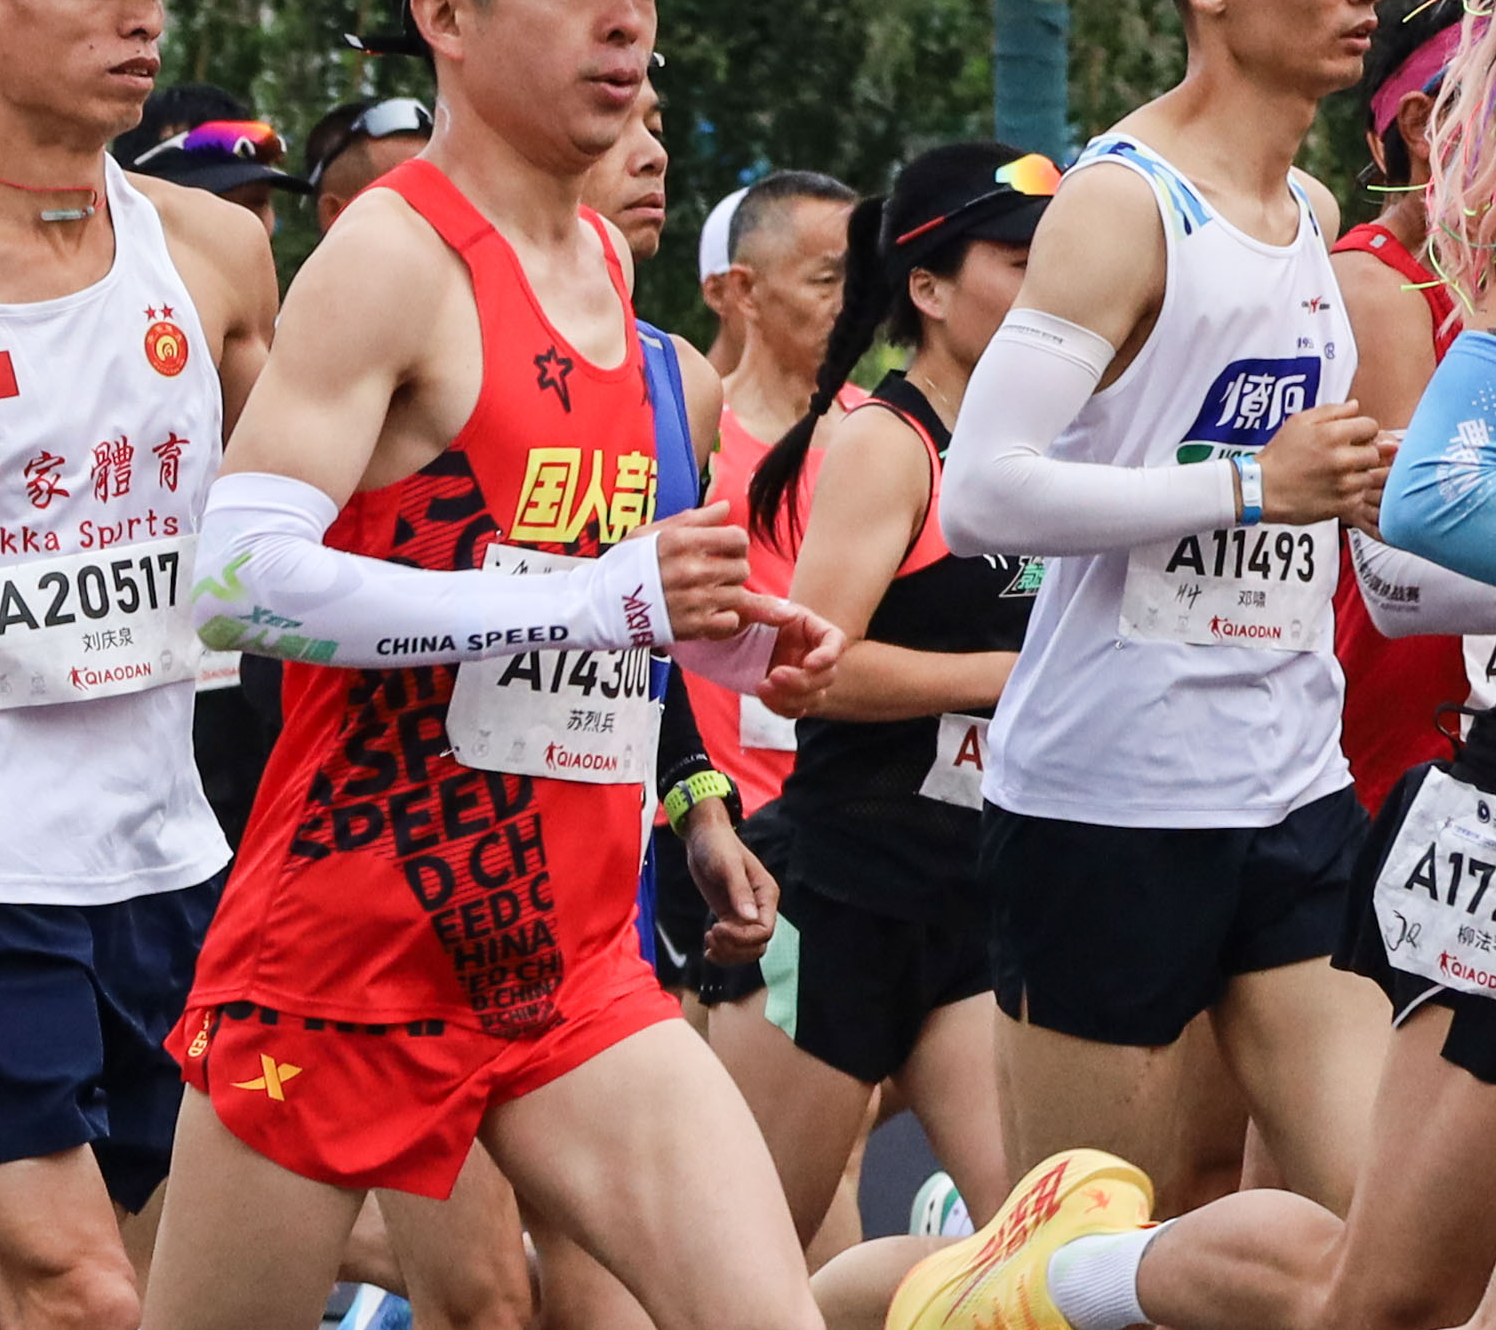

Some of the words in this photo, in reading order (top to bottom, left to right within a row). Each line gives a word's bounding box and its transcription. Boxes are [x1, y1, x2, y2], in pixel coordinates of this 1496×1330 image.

[1165, 530, 1315, 583] A11493
[81, 626, 135, 653] 刘庆泉
[376, 635, 456, 656] CHINA
[467, 625, 570, 652] SPEED
[1222, 621, 1282, 639] QIAODAN
[86, 661, 152, 686] QIAODAN
[567, 708, 616, 734] 苏烈兵
[557, 750, 618, 771] QIAODAN
[1405, 841, 1496, 918] A17
[1458, 922, 1496, 953] 柳法
